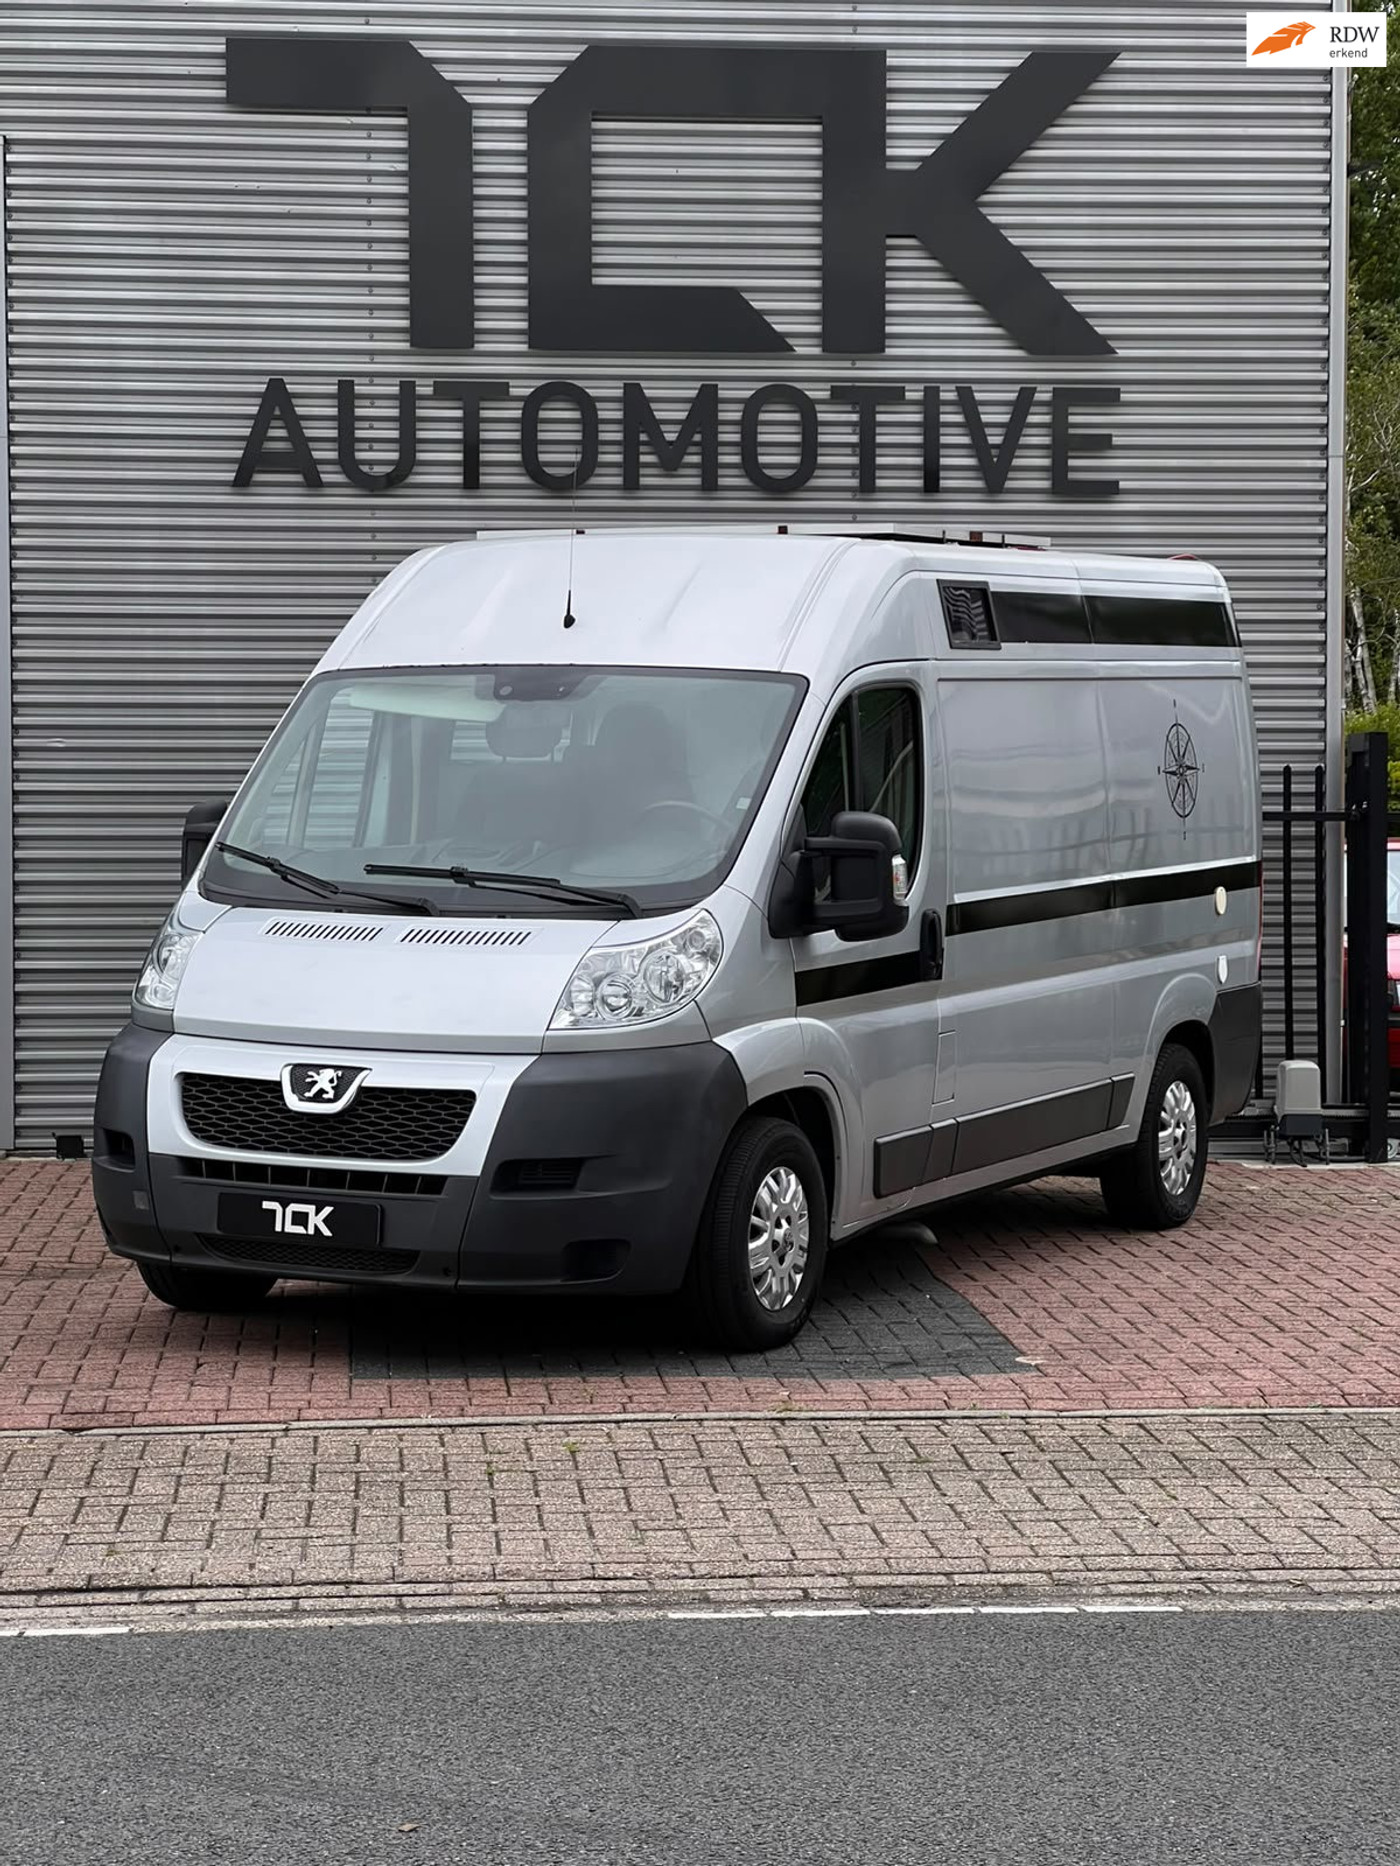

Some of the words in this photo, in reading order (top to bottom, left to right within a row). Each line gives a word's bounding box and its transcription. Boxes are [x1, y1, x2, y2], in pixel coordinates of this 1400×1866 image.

[226, 38, 1122, 356] TCK
[232, 377, 1121, 498] AUTOMOTIVE
[262, 1200, 335, 1237] TCK
